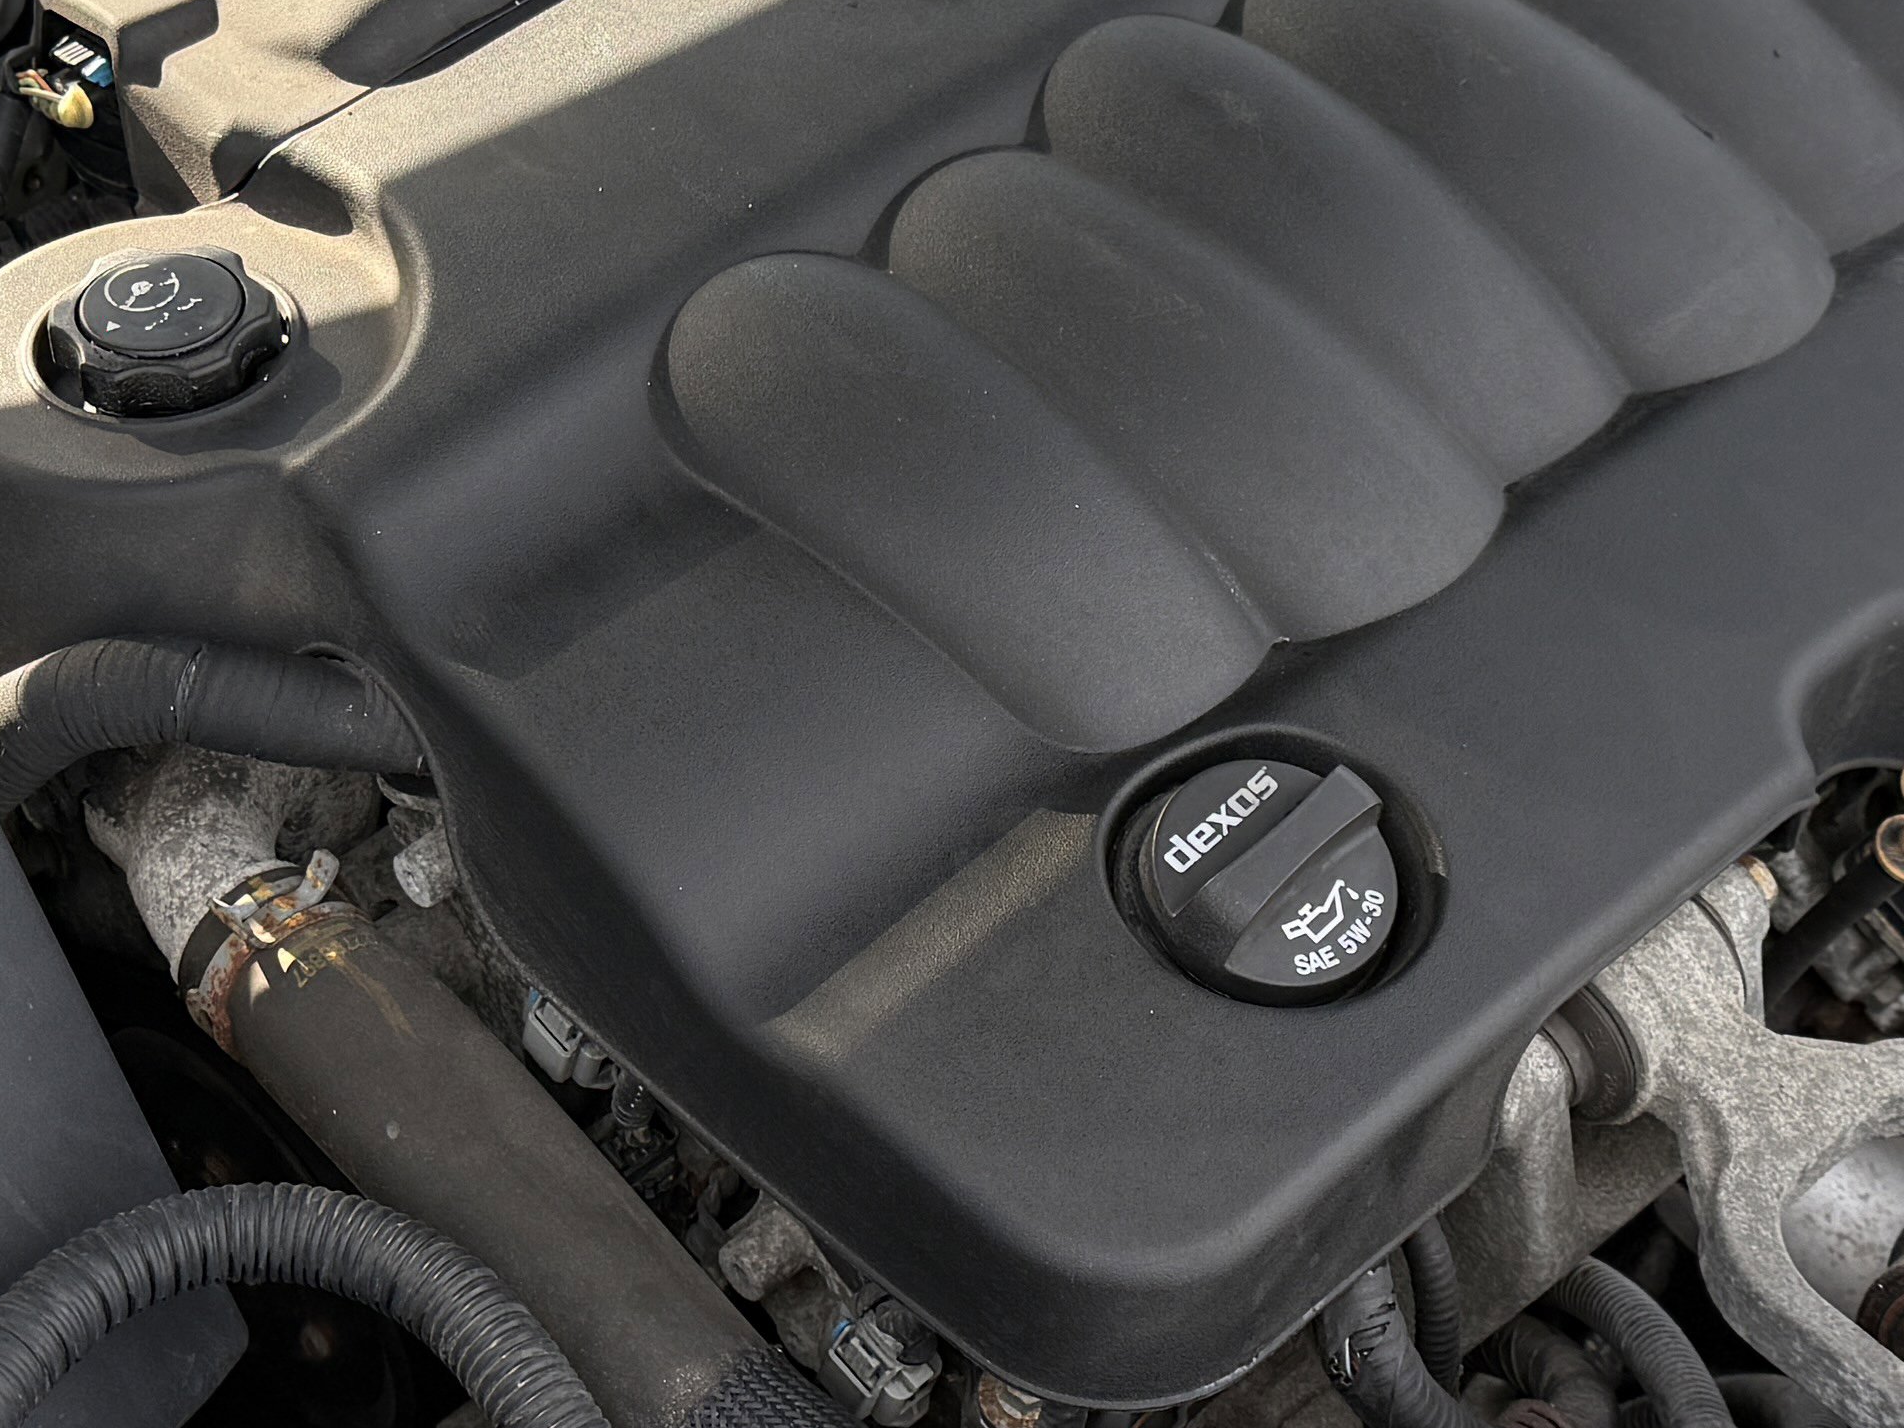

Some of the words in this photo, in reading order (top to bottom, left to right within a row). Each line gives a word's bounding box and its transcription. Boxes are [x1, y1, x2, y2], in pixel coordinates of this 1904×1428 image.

[1164, 766, 1279, 873] dexos
[1294, 944, 1340, 976] SAE
[1337, 888, 1386, 954] 5W-30
